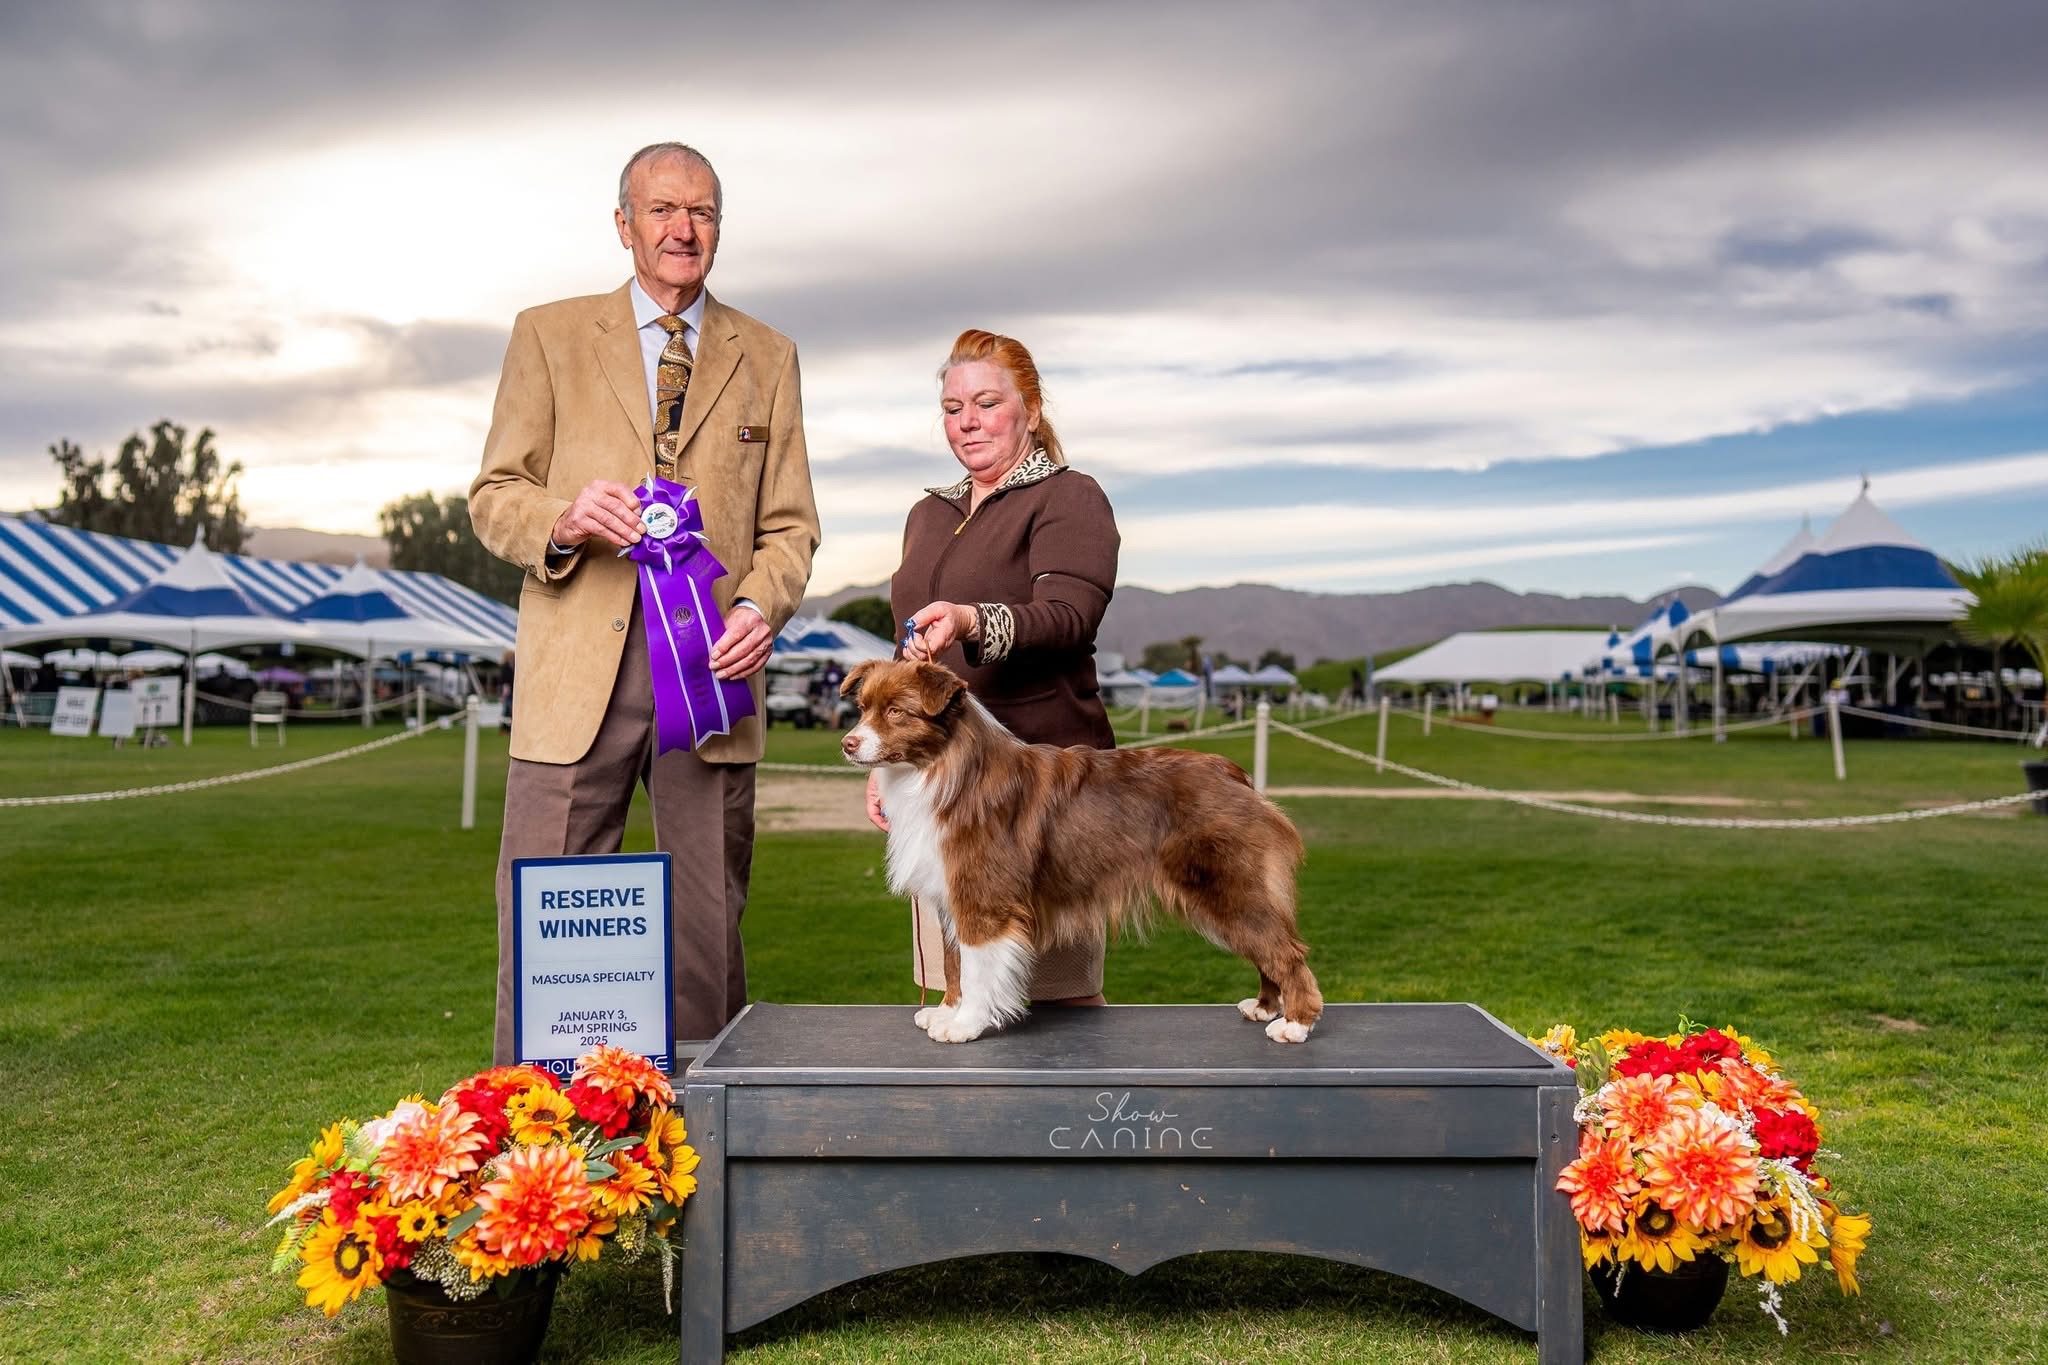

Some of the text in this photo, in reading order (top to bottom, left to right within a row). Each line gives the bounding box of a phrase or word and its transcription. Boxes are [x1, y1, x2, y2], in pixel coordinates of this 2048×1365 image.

[541, 887, 645, 910] RESERVE
[539, 916, 647, 939] WINNERS
[532, 970, 656, 985] MASCUSA SPECIALTY
[558, 1009, 628, 1022] JANUARY 3,
[551, 1021, 637, 1035] PALM SPRINGS
[580, 1035, 608, 1046] 2025
[1088, 1091, 1179, 1124] Show
